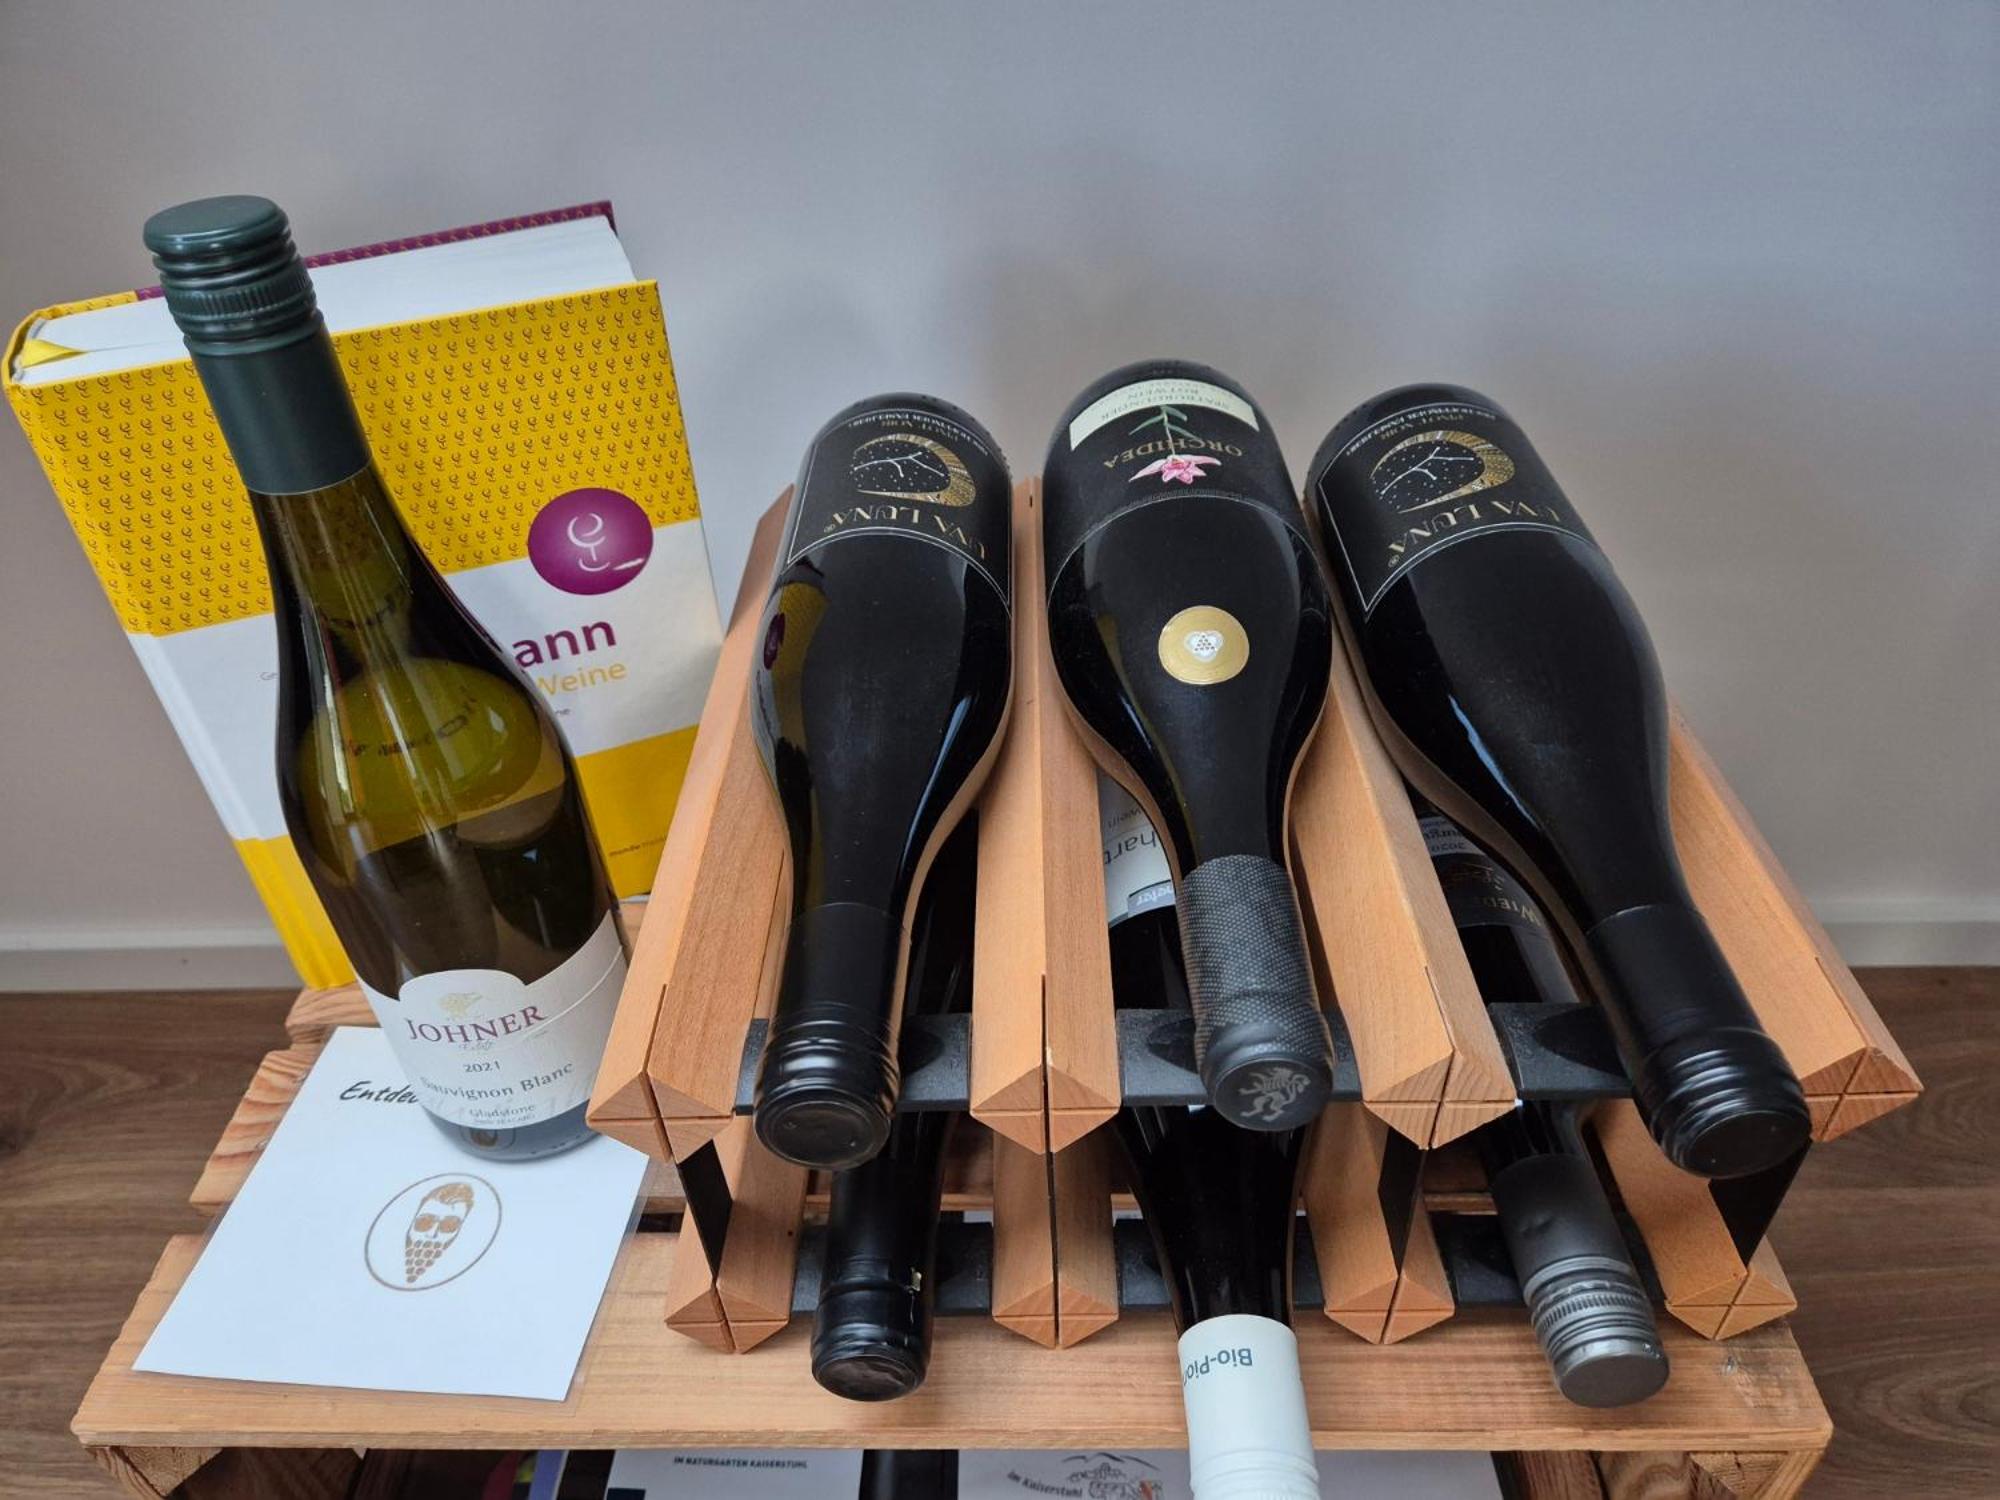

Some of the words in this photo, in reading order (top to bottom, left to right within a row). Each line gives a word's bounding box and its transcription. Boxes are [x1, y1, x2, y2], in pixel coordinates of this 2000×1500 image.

[1103, 437, 1243, 469] ORCHIDEA
[405, 1005, 548, 1043] JOHNER
[463, 1060, 502, 1073] 2021
[420, 1076, 514, 1101] Sauvignon
[520, 1062, 574, 1092] Blanc
[469, 1104, 536, 1119] Gladstone
[686, 1457, 748, 1468] NATURGARTEN
[750, 1460, 807, 1469] KAISERSTUHL
[1022, 1476, 1083, 1498] Kaiserstuhl
